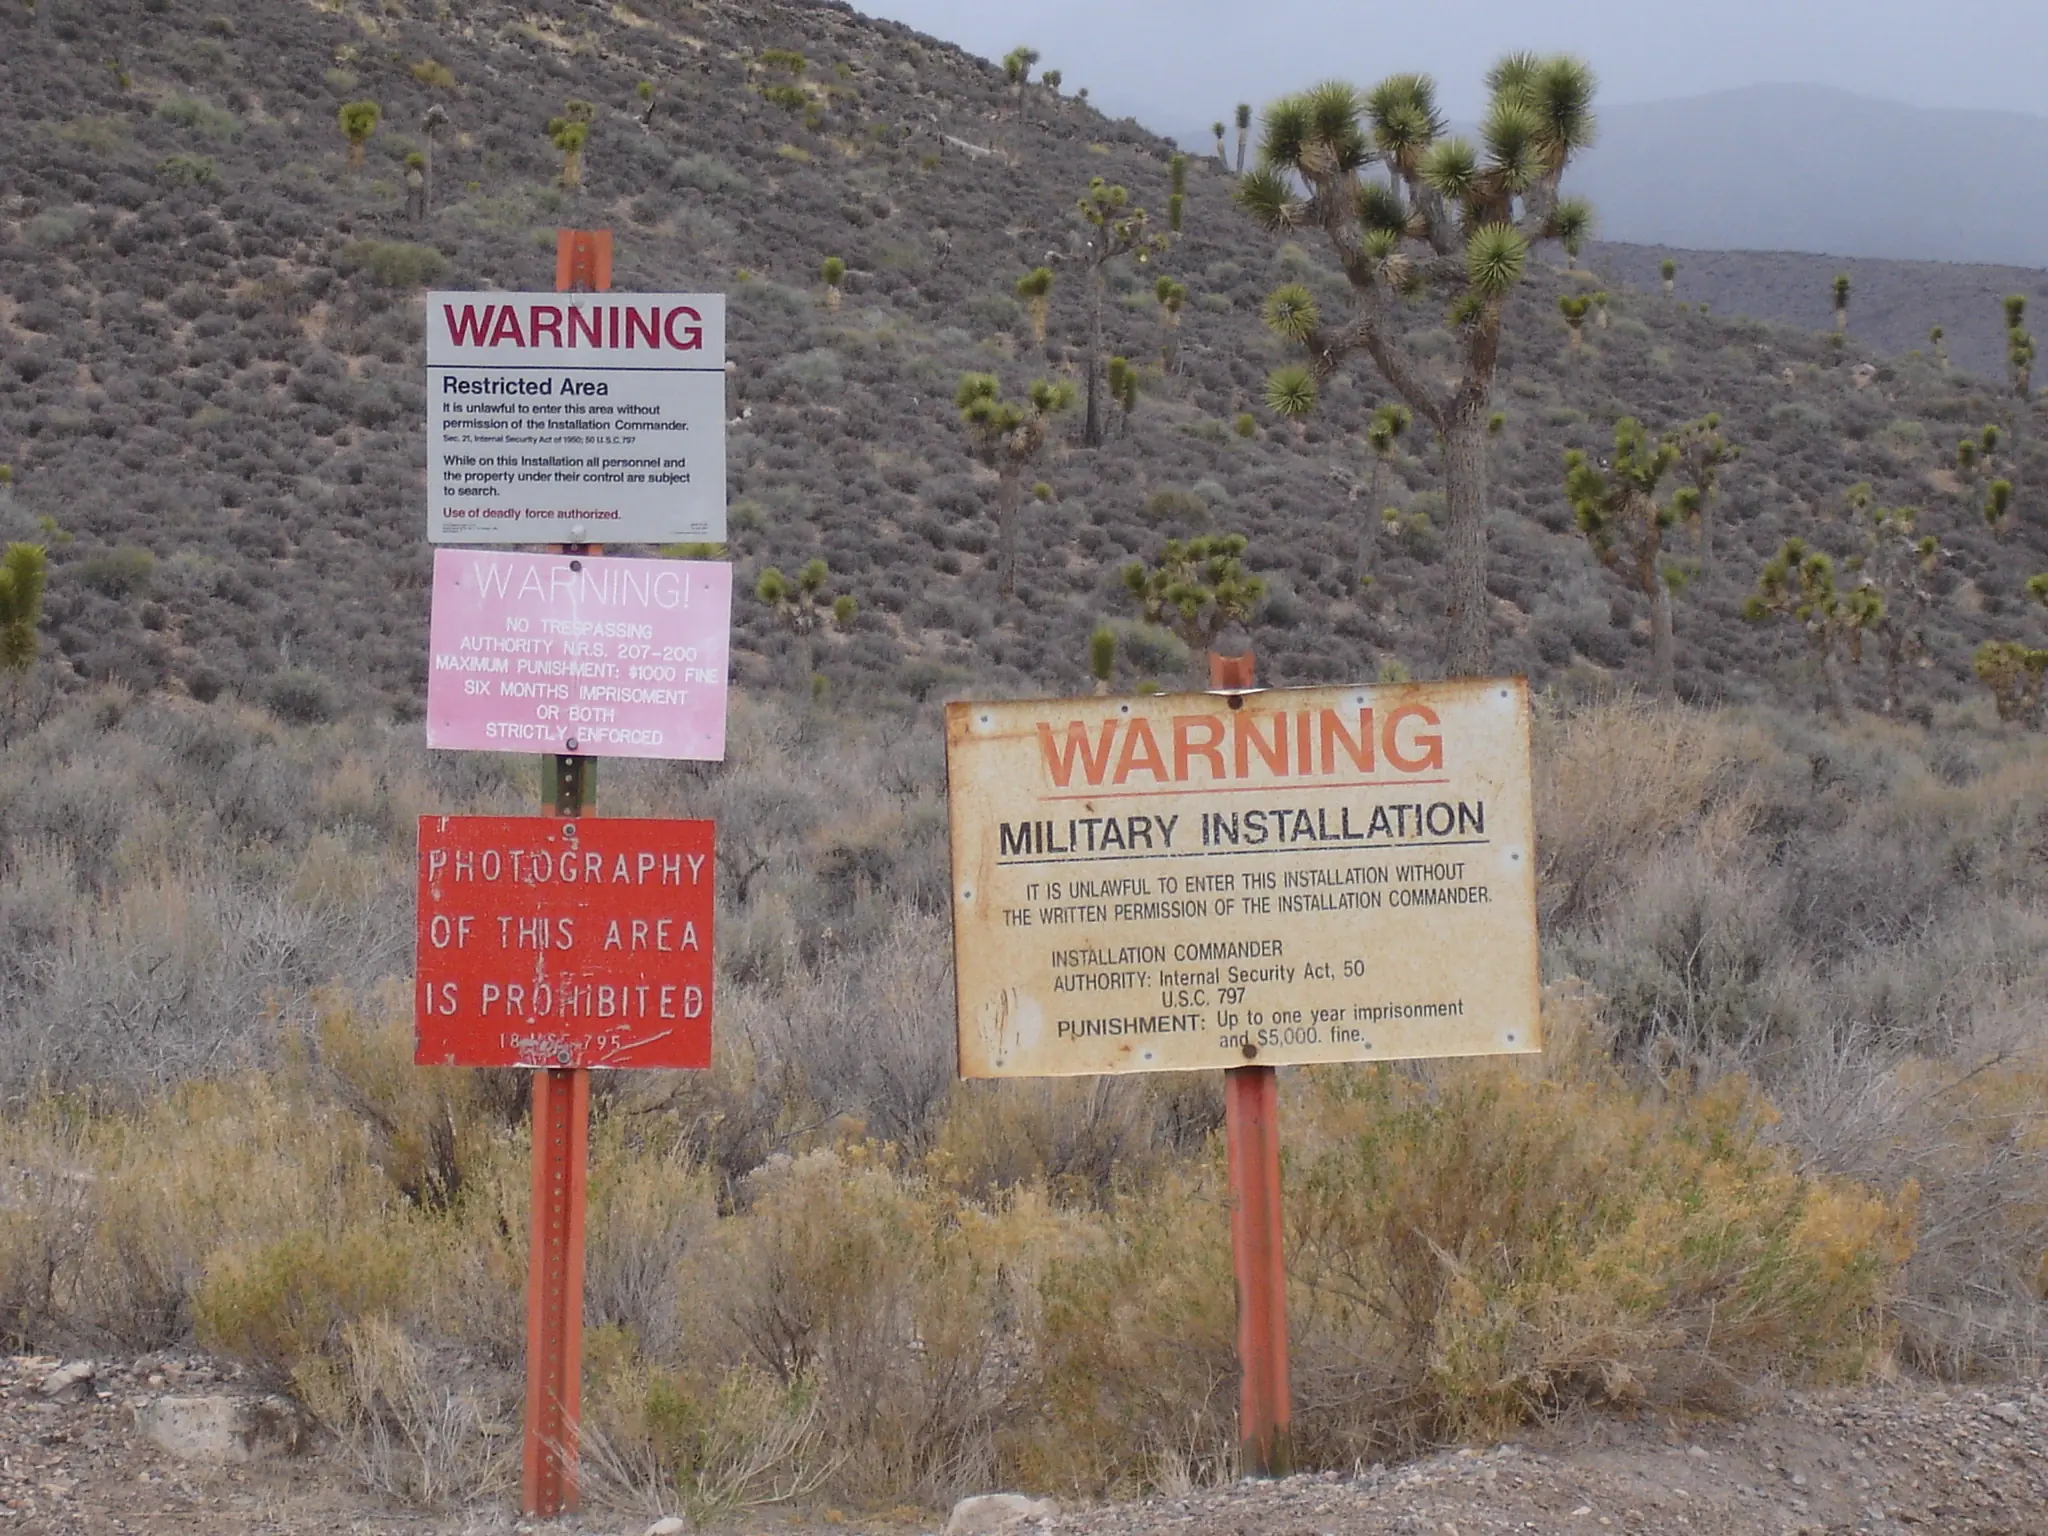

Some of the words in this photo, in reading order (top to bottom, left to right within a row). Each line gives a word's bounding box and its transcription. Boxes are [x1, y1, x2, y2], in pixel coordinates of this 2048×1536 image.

[443, 304, 703, 350] WARNING
[443, 375, 552, 395] Restricted
[560, 377, 608, 396] Area
[443, 402, 450, 413] It
[453, 402, 463, 413] is
[466, 402, 515, 414] unlawful
[518, 403, 529, 414] to
[532, 403, 561, 414] enter
[564, 403, 586, 415] this
[588, 405, 614, 416] area
[616, 404, 660, 416] without
[443, 418, 508, 430] permission
[510, 420, 523, 430] of
[527, 420, 545, 430] the
[548, 419, 610, 430] Installation
[614, 420, 689, 432] Commander.
[443, 455, 476, 467] While
[478, 457, 494, 467] on
[497, 456, 518, 467] this
[521, 456, 584, 468] Installation
[586, 457, 600, 468] all
[602, 457, 661, 470] personnel
[663, 457, 686, 468] and
[443, 470, 462, 481] the
[464, 471, 515, 484] property
[518, 471, 552, 482] under
[554, 471, 580, 483] their
[582, 471, 624, 483] control
[626, 474, 646, 484] are
[648, 471, 691, 486] subject
[443, 486, 456, 497] to
[458, 486, 500, 497] search.
[443, 507, 466, 519] Use
[468, 508, 480, 519] of
[482, 508, 522, 521] deadly
[525, 508, 555, 519] force
[557, 509, 622, 520] authorized.
[474, 562, 690, 609] WARNING!
[506, 616, 530, 632] NO
[541, 618, 654, 640] TRESPASSING
[460, 635, 555, 653] AUTHORITY
[618, 643, 698, 662] 207-200
[435, 655, 510, 674] MAXIMUM
[517, 658, 621, 680] PUNISHMENT:
[628, 667, 677, 683] $1000
[685, 668, 720, 685] FINE
[463, 679, 492, 697] SIX
[500, 681, 570, 700] MONTHS
[579, 684, 689, 706] IMPRISOMENT
[536, 704, 561, 722] OR
[568, 706, 615, 724] BOTH
[485, 722, 567, 741] STRICTLY
[577, 726, 664, 746] ENFORCED
[1035, 704, 1445, 788] WARNING
[999, 814, 1178, 856] MILITARY
[1202, 800, 1485, 846] INSTALLATION
[427, 850, 706, 887] PHOTOGRAPHY
[1026, 883, 1040, 900] IT
[1046, 882, 1062, 900] IS
[1068, 877, 1151, 899] UNLAWFUL
[1156, 876, 1178, 894] TO
[1185, 873, 1235, 893] ENTER
[1242, 871, 1277, 890] THIS
[1283, 865, 1389, 888] INSTALLATION
[1395, 862, 1466, 883] WITHOUT
[1002, 908, 1032, 926] THE
[1039, 904, 1107, 925] WRITTEN
[1114, 900, 1207, 921] PERMISSION
[1214, 898, 1235, 916] OF
[1242, 896, 1271, 914] THE
[1278, 891, 1382, 913] INSTALLATION
[1389, 886, 1493, 908] COMMANDER.
[430, 914, 475, 949] OF
[497, 915, 574, 951] THIS
[603, 918, 700, 952] AREA
[1051, 945, 1166, 968] INSTALLATION
[1173, 939, 1283, 962] COMMANDER
[1053, 971, 1152, 993] AUTHORITY:
[1159, 967, 1220, 987] Internal
[1227, 964, 1295, 984] Security
[1303, 962, 1335, 981] Act,
[1343, 959, 1366, 978] 50
[426, 982, 458, 1016] IS
[481, 984, 704, 1019] PROHIBITED
[1161, 989, 1210, 1009] U.S.C.
[1217, 986, 1246, 1005] 797
[1057, 1014, 1207, 1038] PUNISHMENT:
[1216, 1010, 1239, 1031] Up
[1246, 1009, 1264, 1026] to
[1271, 1007, 1303, 1025] one
[1310, 1006, 1347, 1026] year
[1353, 1000, 1464, 1024] imprisonment
[500, 1033, 518, 1049] 18
[584, 1034, 621, 1051] 795
[1219, 1031, 1250, 1050] and
[1256, 1027, 1323, 1047] $5,000.
[1330, 1026, 1366, 1044] fine.
